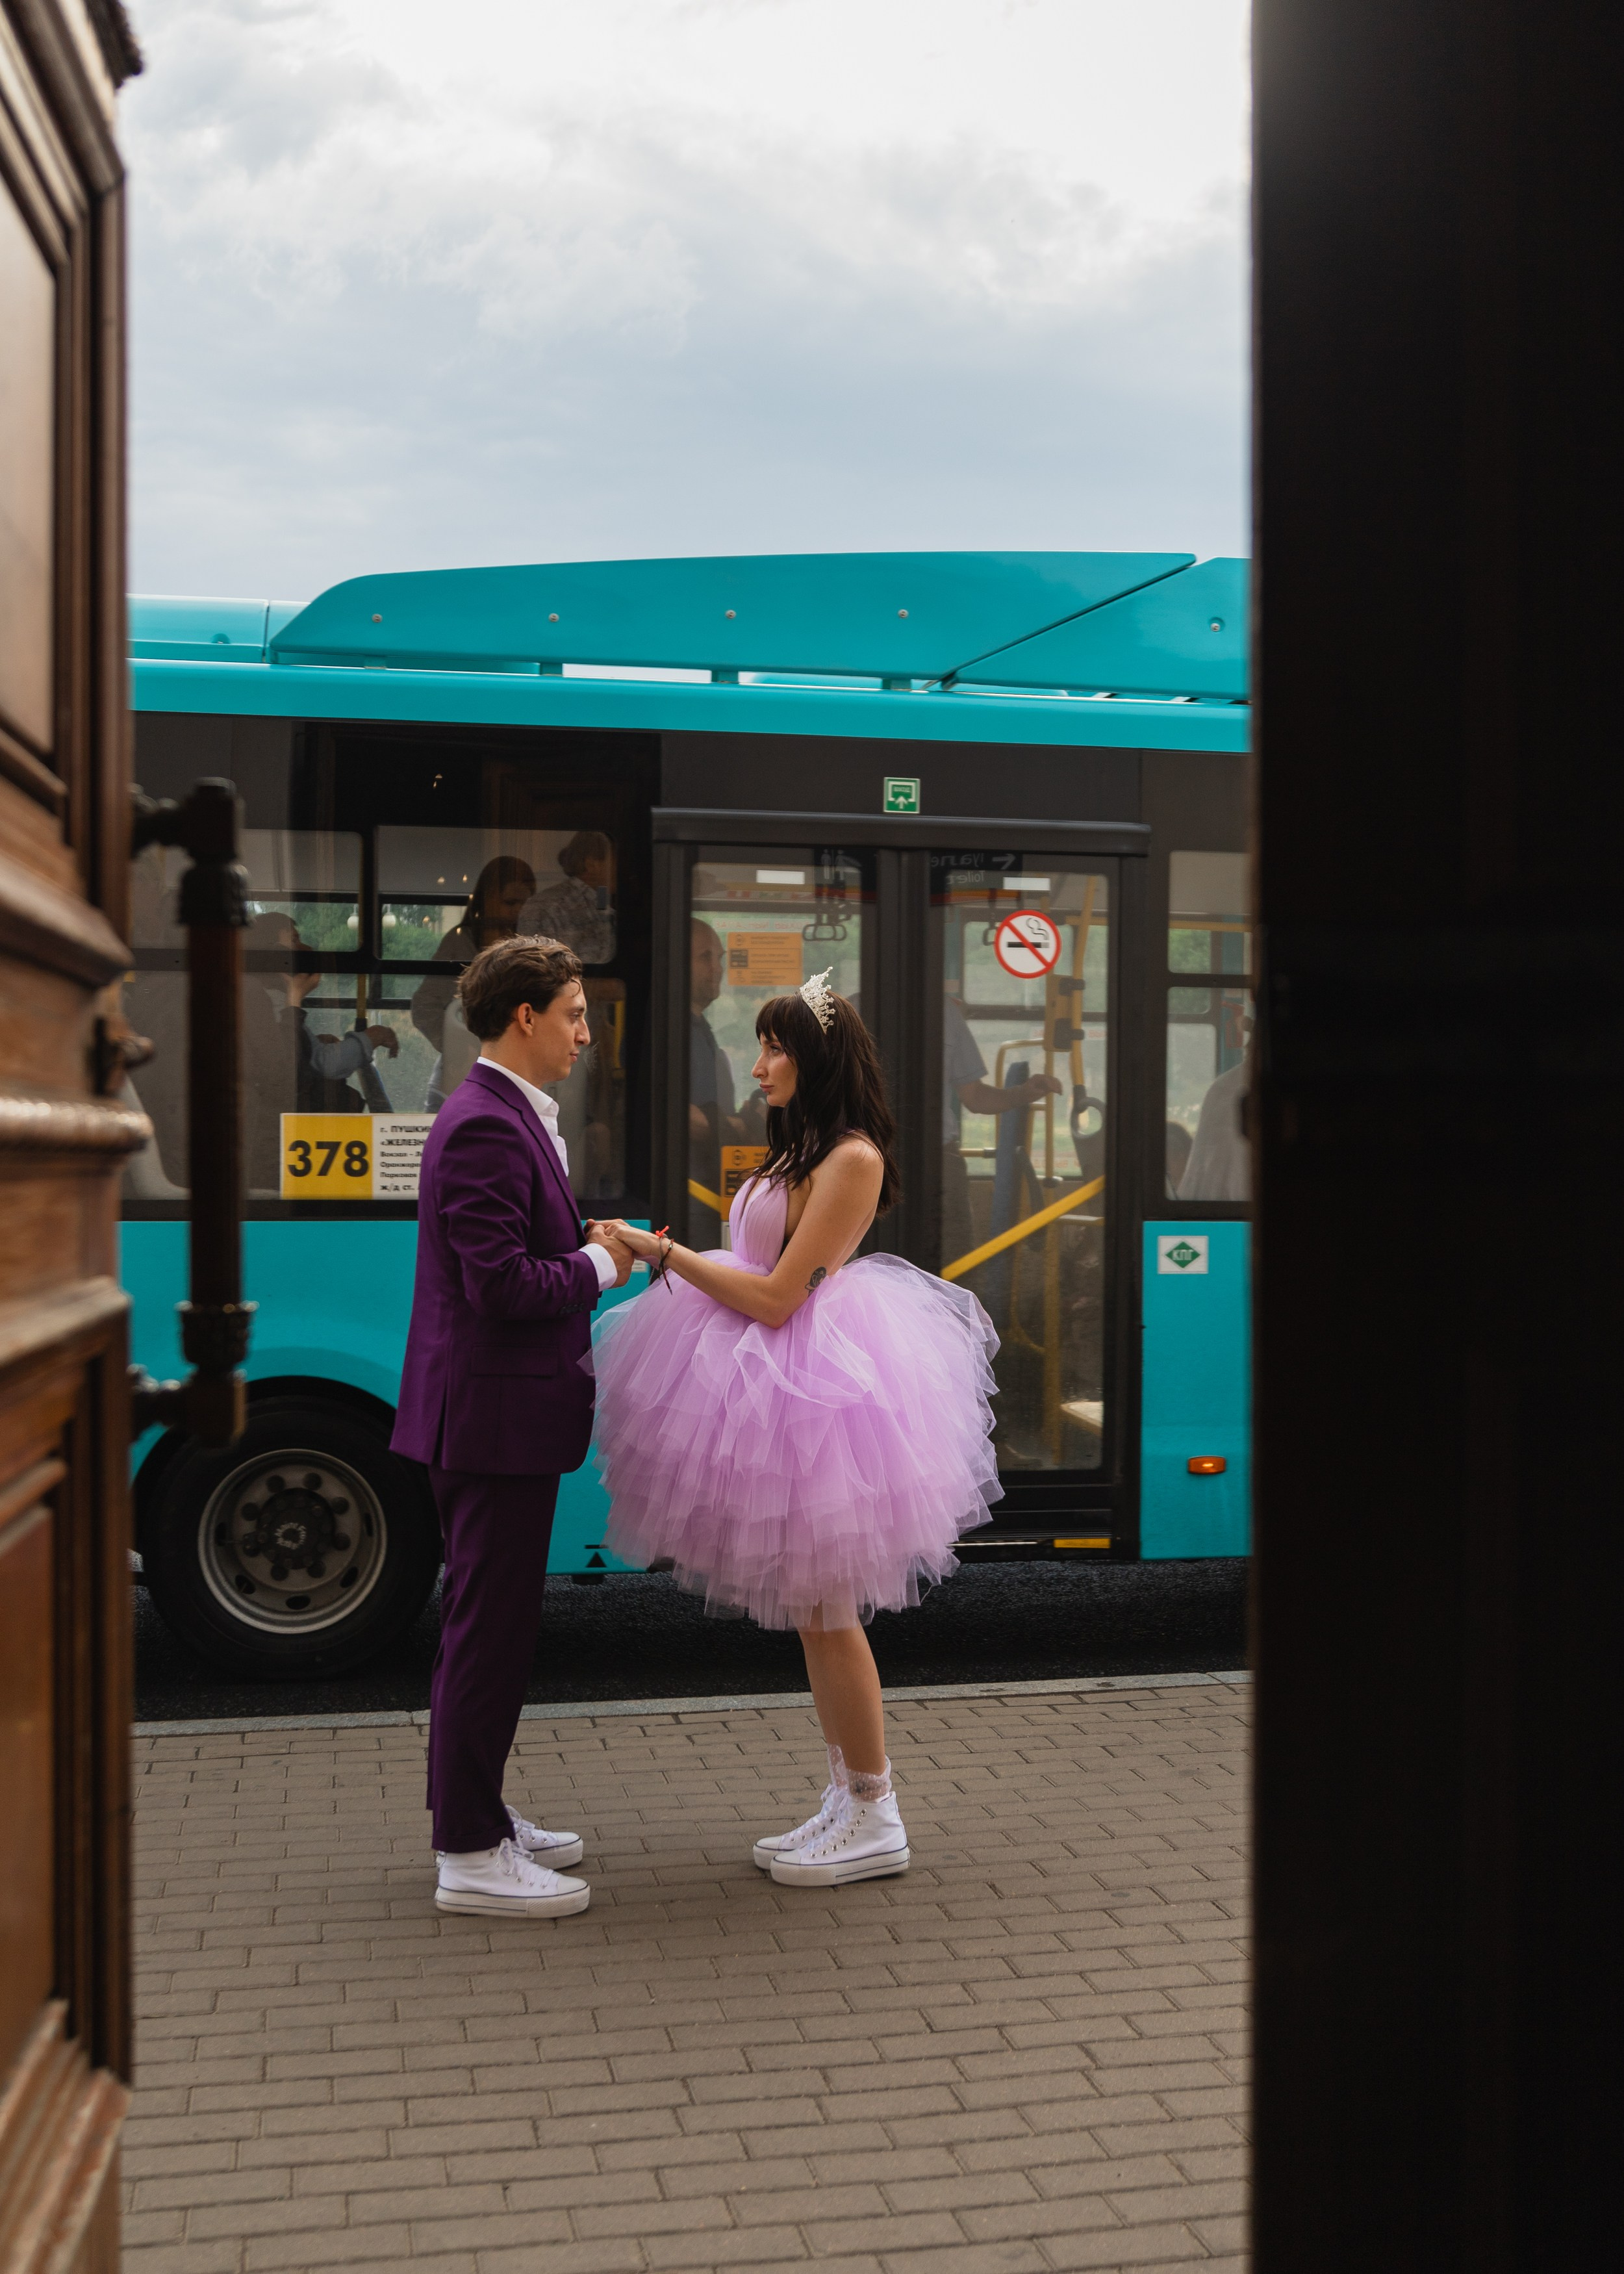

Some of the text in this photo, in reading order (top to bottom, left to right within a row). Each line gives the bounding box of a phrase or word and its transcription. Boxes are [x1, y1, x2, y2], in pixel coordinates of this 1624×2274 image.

[288, 1140, 370, 1177] 378
[379, 1183, 400, 1192] ж/д
[1172, 1249, 1194, 1260] КПГ
